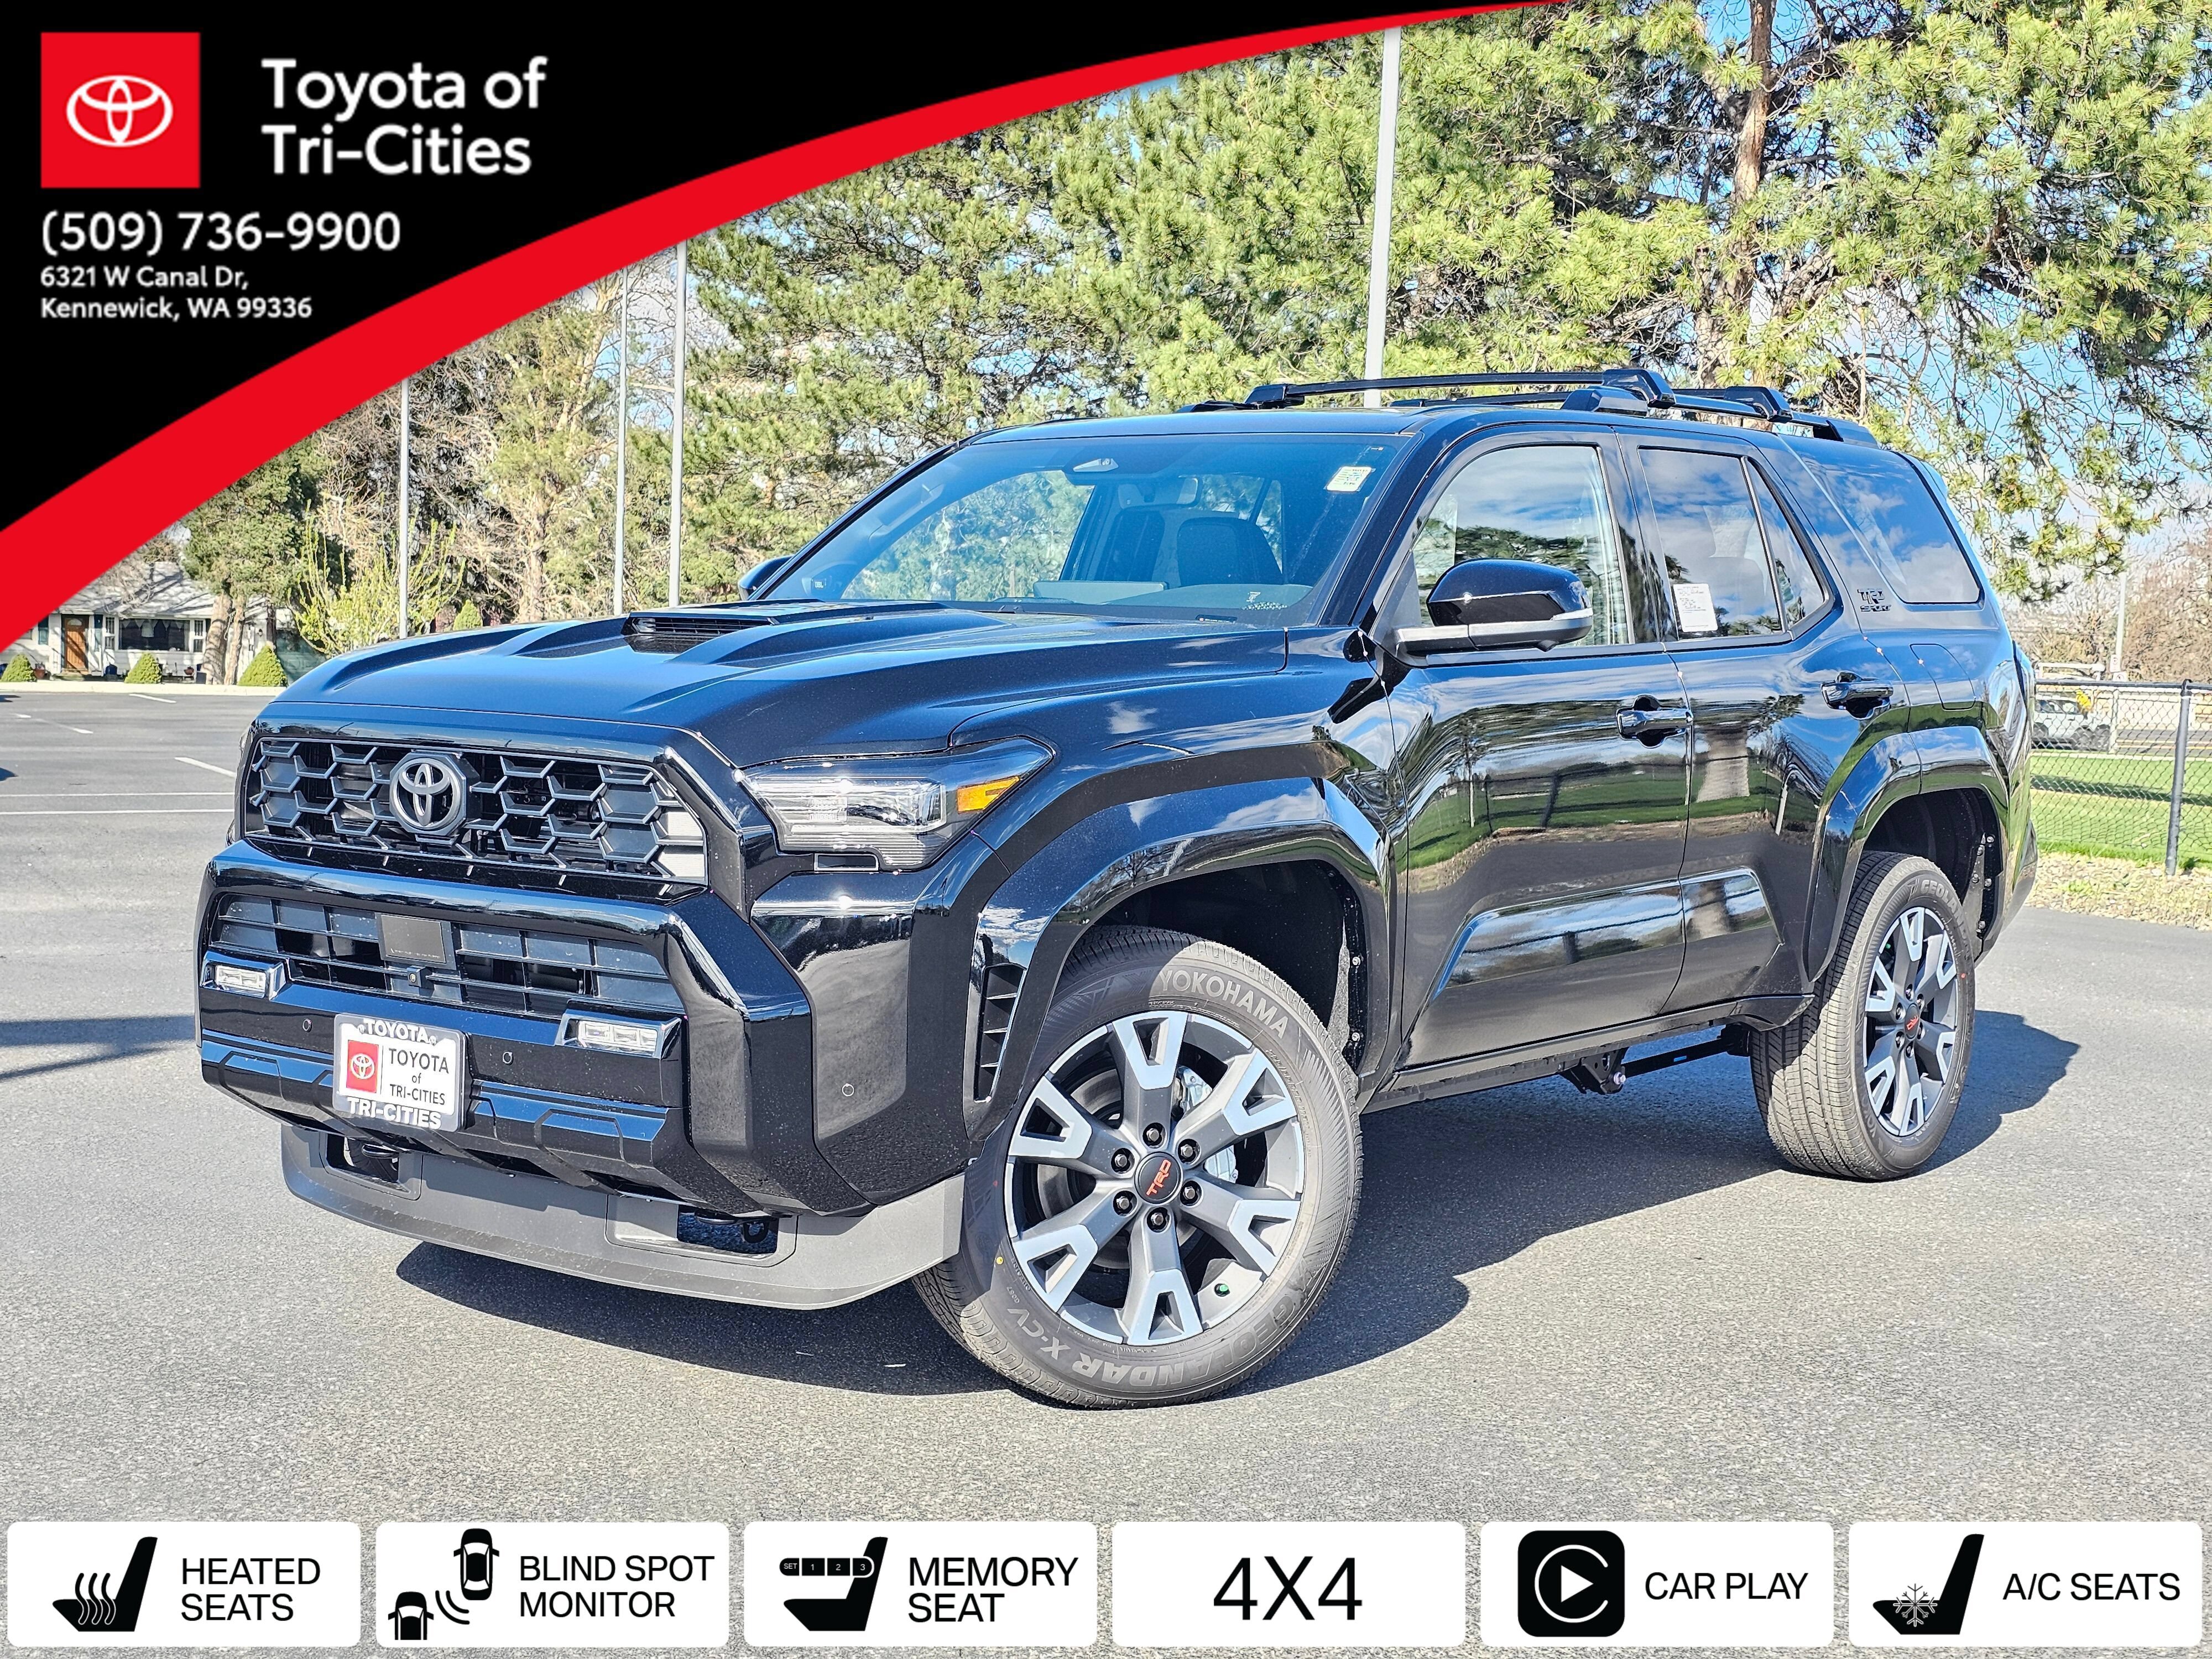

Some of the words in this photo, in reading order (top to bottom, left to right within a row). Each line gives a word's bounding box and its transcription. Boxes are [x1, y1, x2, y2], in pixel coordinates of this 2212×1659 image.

[1159, 970, 1288, 1040] YOKOHAMA
[363, 1018, 429, 1044] TOYOTA
[389, 1047, 449, 1074] TOYOTA
[389, 1084, 445, 1105] TRI-CITIES
[411, 1073, 421, 1084] of
[347, 1097, 442, 1130] TRI-CITIES
[1146, 1159, 1171, 1196] TRD
[1006, 1308, 1071, 1360] X-CV
[1072, 1296, 1296, 1387] GEOLANDAR
